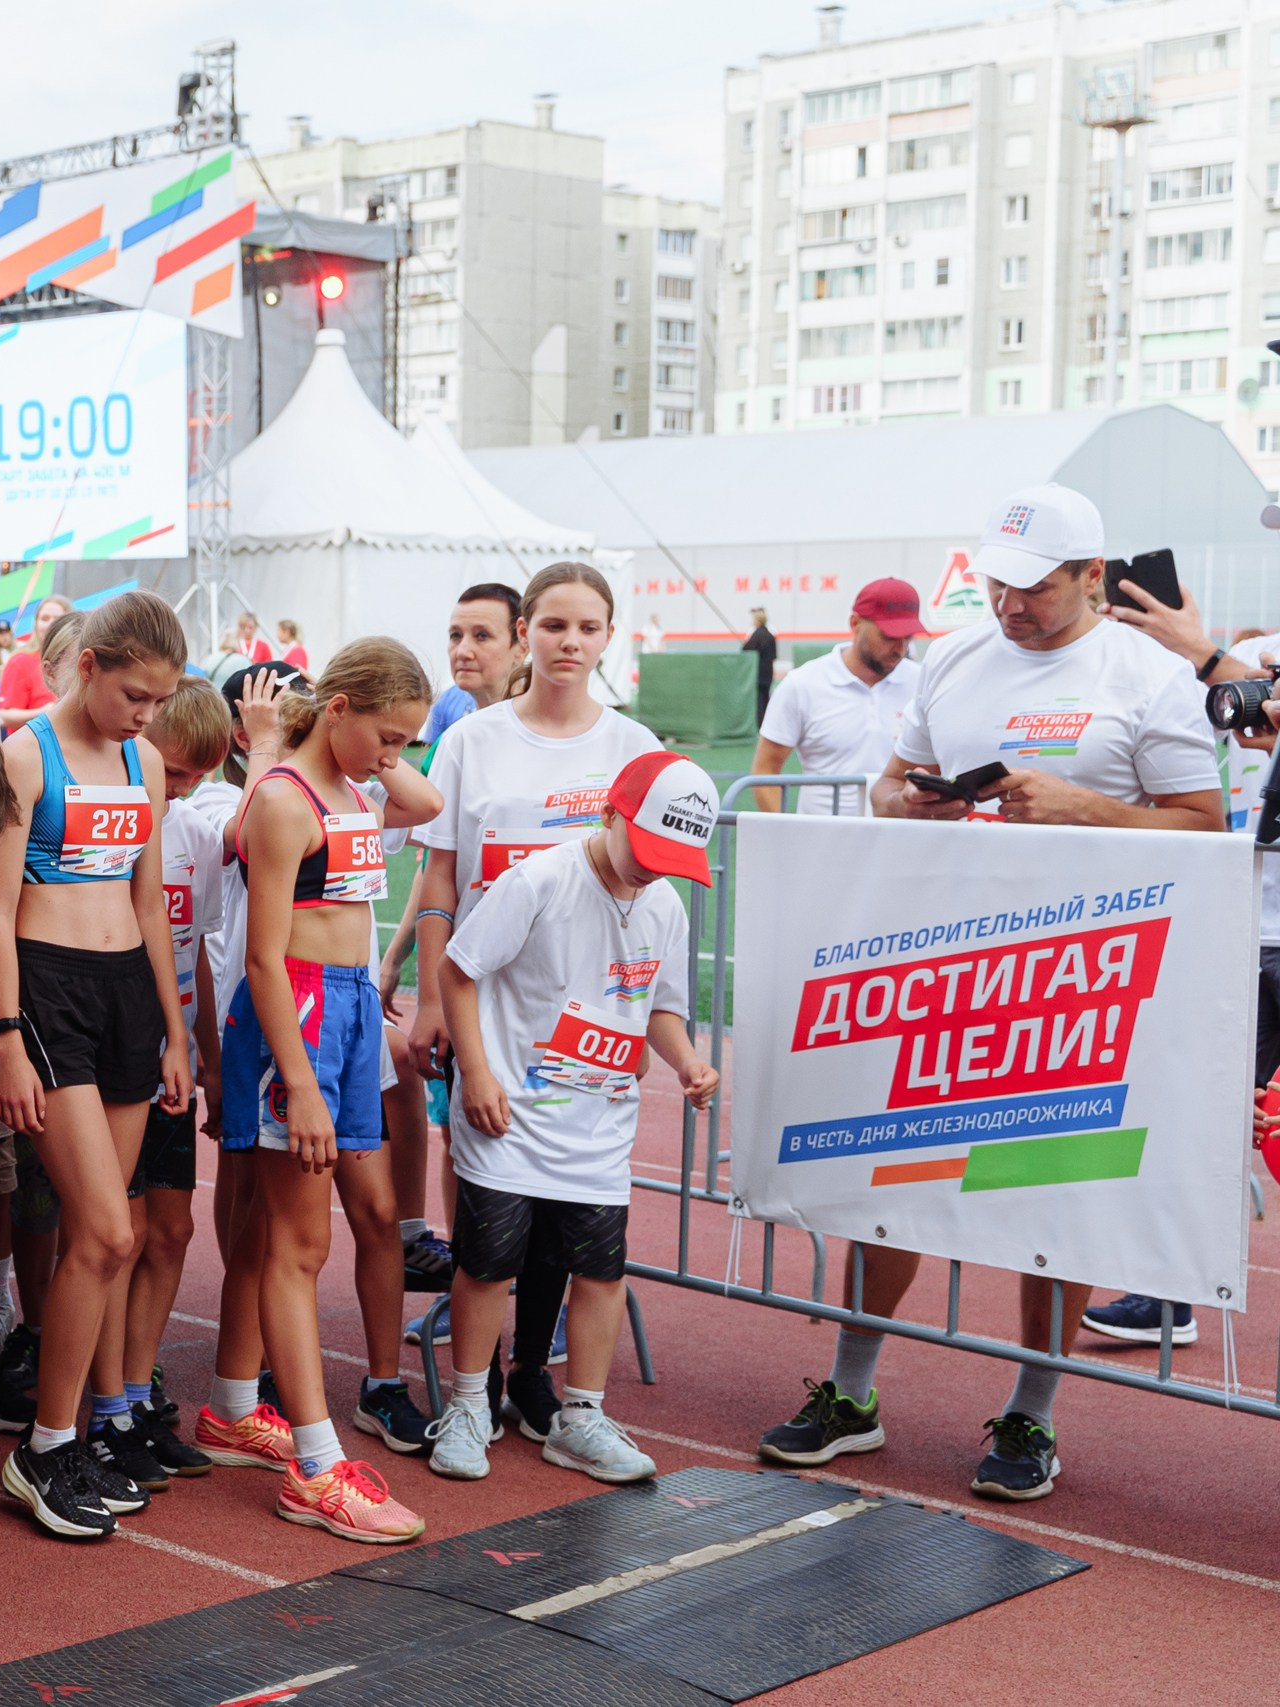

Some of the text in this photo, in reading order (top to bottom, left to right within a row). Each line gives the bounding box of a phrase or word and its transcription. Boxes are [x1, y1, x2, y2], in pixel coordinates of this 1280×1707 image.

[735, 575, 839, 593] МАНЕЖ
[1011, 714, 1087, 728] ДОСТИГАЯ
[1029, 726, 1080, 740] ЦЕЛИ!
[91, 809, 138, 839] 273
[661, 813, 709, 839] ULTRA
[507, 849, 546, 867] 5
[813, 882, 1175, 968] БЛАГОТВОРИТЕЛЬНЫЙ ЗАБЕГ
[806, 933, 1138, 1046] ДОСТИГАЯ
[577, 1029, 632, 1067] 010
[907, 1005, 1121, 1097] ЦЕЛИ!
[790, 1098, 1113, 1152] В ЧЕСТЬ ДНЯ ЖЕЛЕЗНОДОРОЖНИКА
